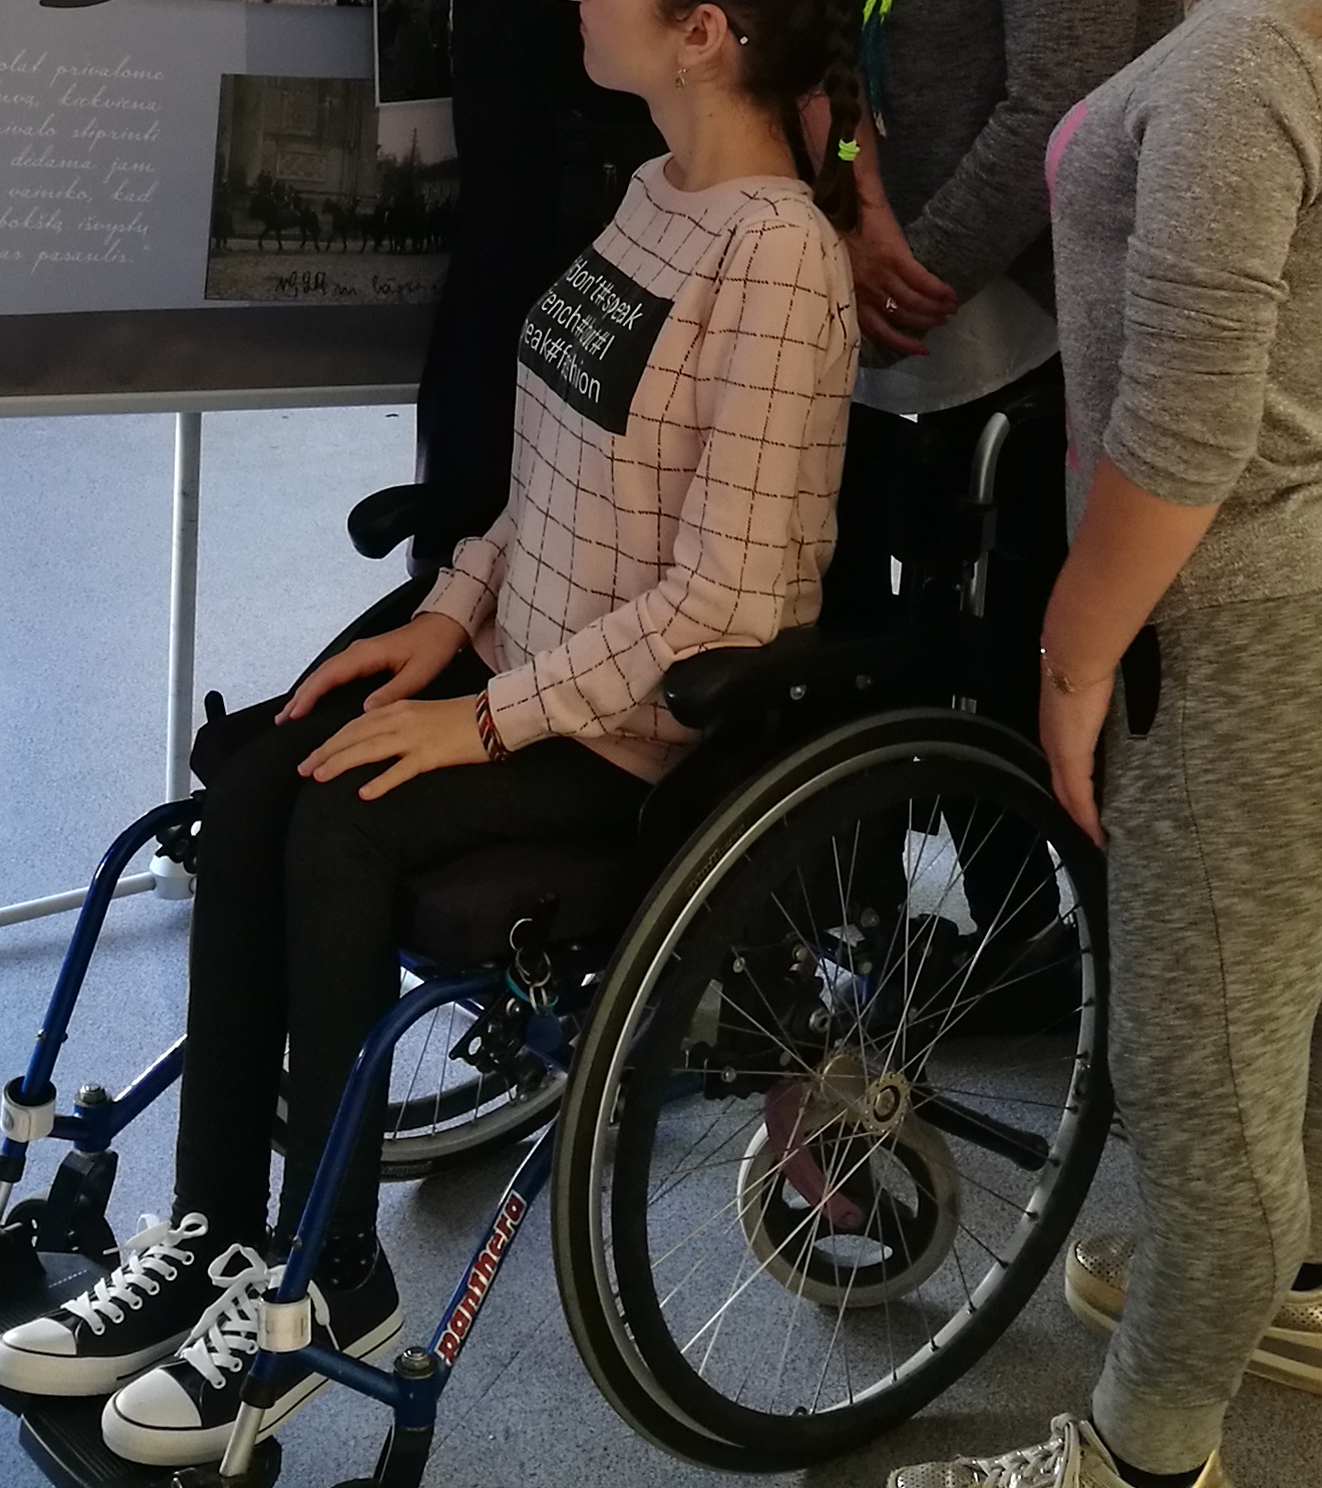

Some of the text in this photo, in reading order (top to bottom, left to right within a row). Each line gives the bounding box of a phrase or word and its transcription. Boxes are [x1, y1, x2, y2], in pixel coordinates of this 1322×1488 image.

[50, 54, 166, 87] privalome
[72, 117, 161, 152] stiprinti
[102, 156, 156, 184] jam
[112, 179, 160, 204] kad
[434, 1189, 528, 1367] panthera
